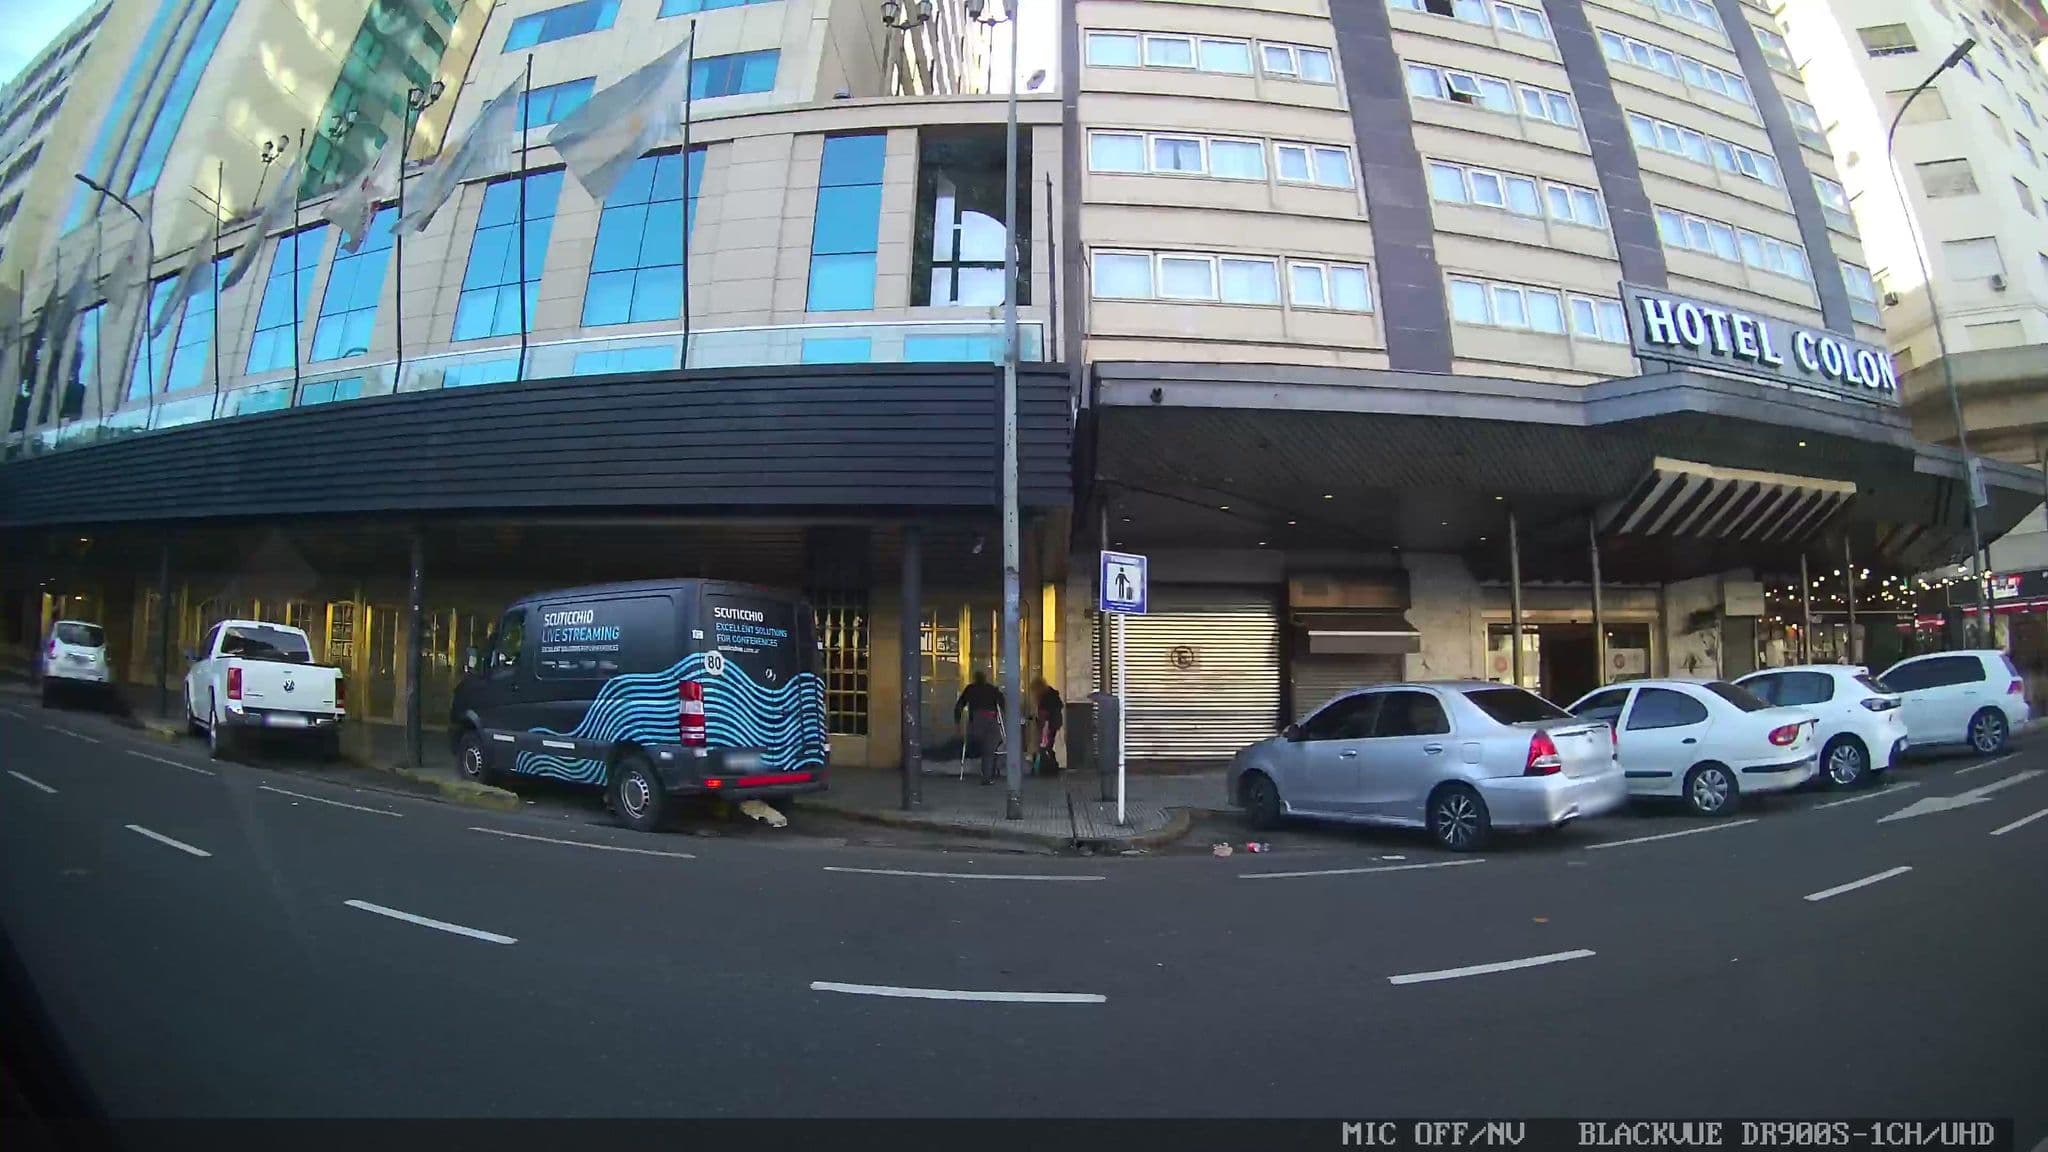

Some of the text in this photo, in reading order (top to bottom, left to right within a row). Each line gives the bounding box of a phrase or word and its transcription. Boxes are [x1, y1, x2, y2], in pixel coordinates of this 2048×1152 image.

[1640, 298, 1897, 391] HOTEL COLON
[544, 610, 594, 627] SCUTICCHIO
[714, 607, 764, 622] SCUTICCHIO
[542, 626, 620, 643] LIVE STREAMING
[716, 622, 788, 637] EXCELLENT SOLUTIONS
[717, 634, 778, 647] FOR CONFERENCES
[708, 655, 721, 669] 80
